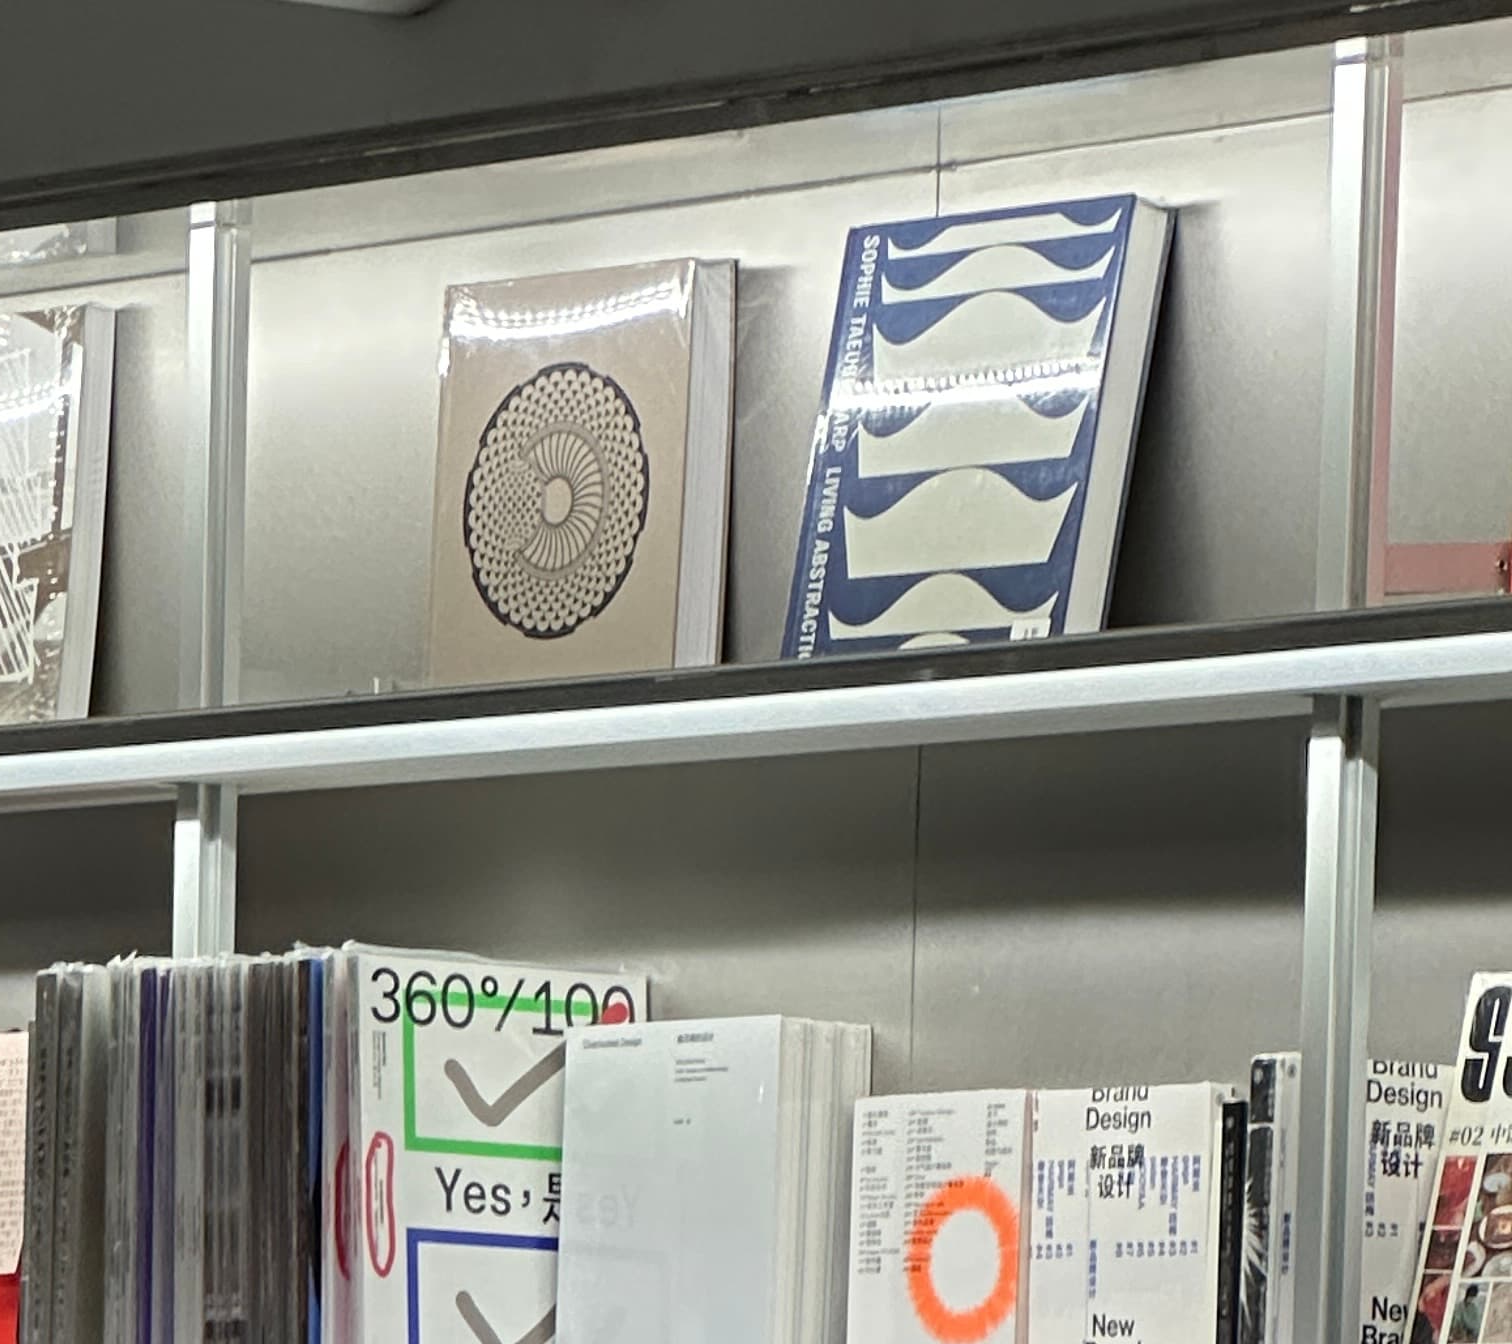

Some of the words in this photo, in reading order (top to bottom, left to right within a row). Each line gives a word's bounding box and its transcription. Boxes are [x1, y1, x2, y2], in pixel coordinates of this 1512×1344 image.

[854, 234, 880, 308] SOPHIE
[818, 466, 842, 531] LIVING
[1366, 1080, 1443, 1113] Design
[1085, 1107, 1152, 1133] Design
[1371, 1119, 1436, 1150] 新品牌
[1090, 1144, 1145, 1170] 新品牌
[1381, 1149, 1424, 1179] 设计
[1098, 1170, 1135, 1199] 设计
[1091, 1314, 1135, 1338] New
